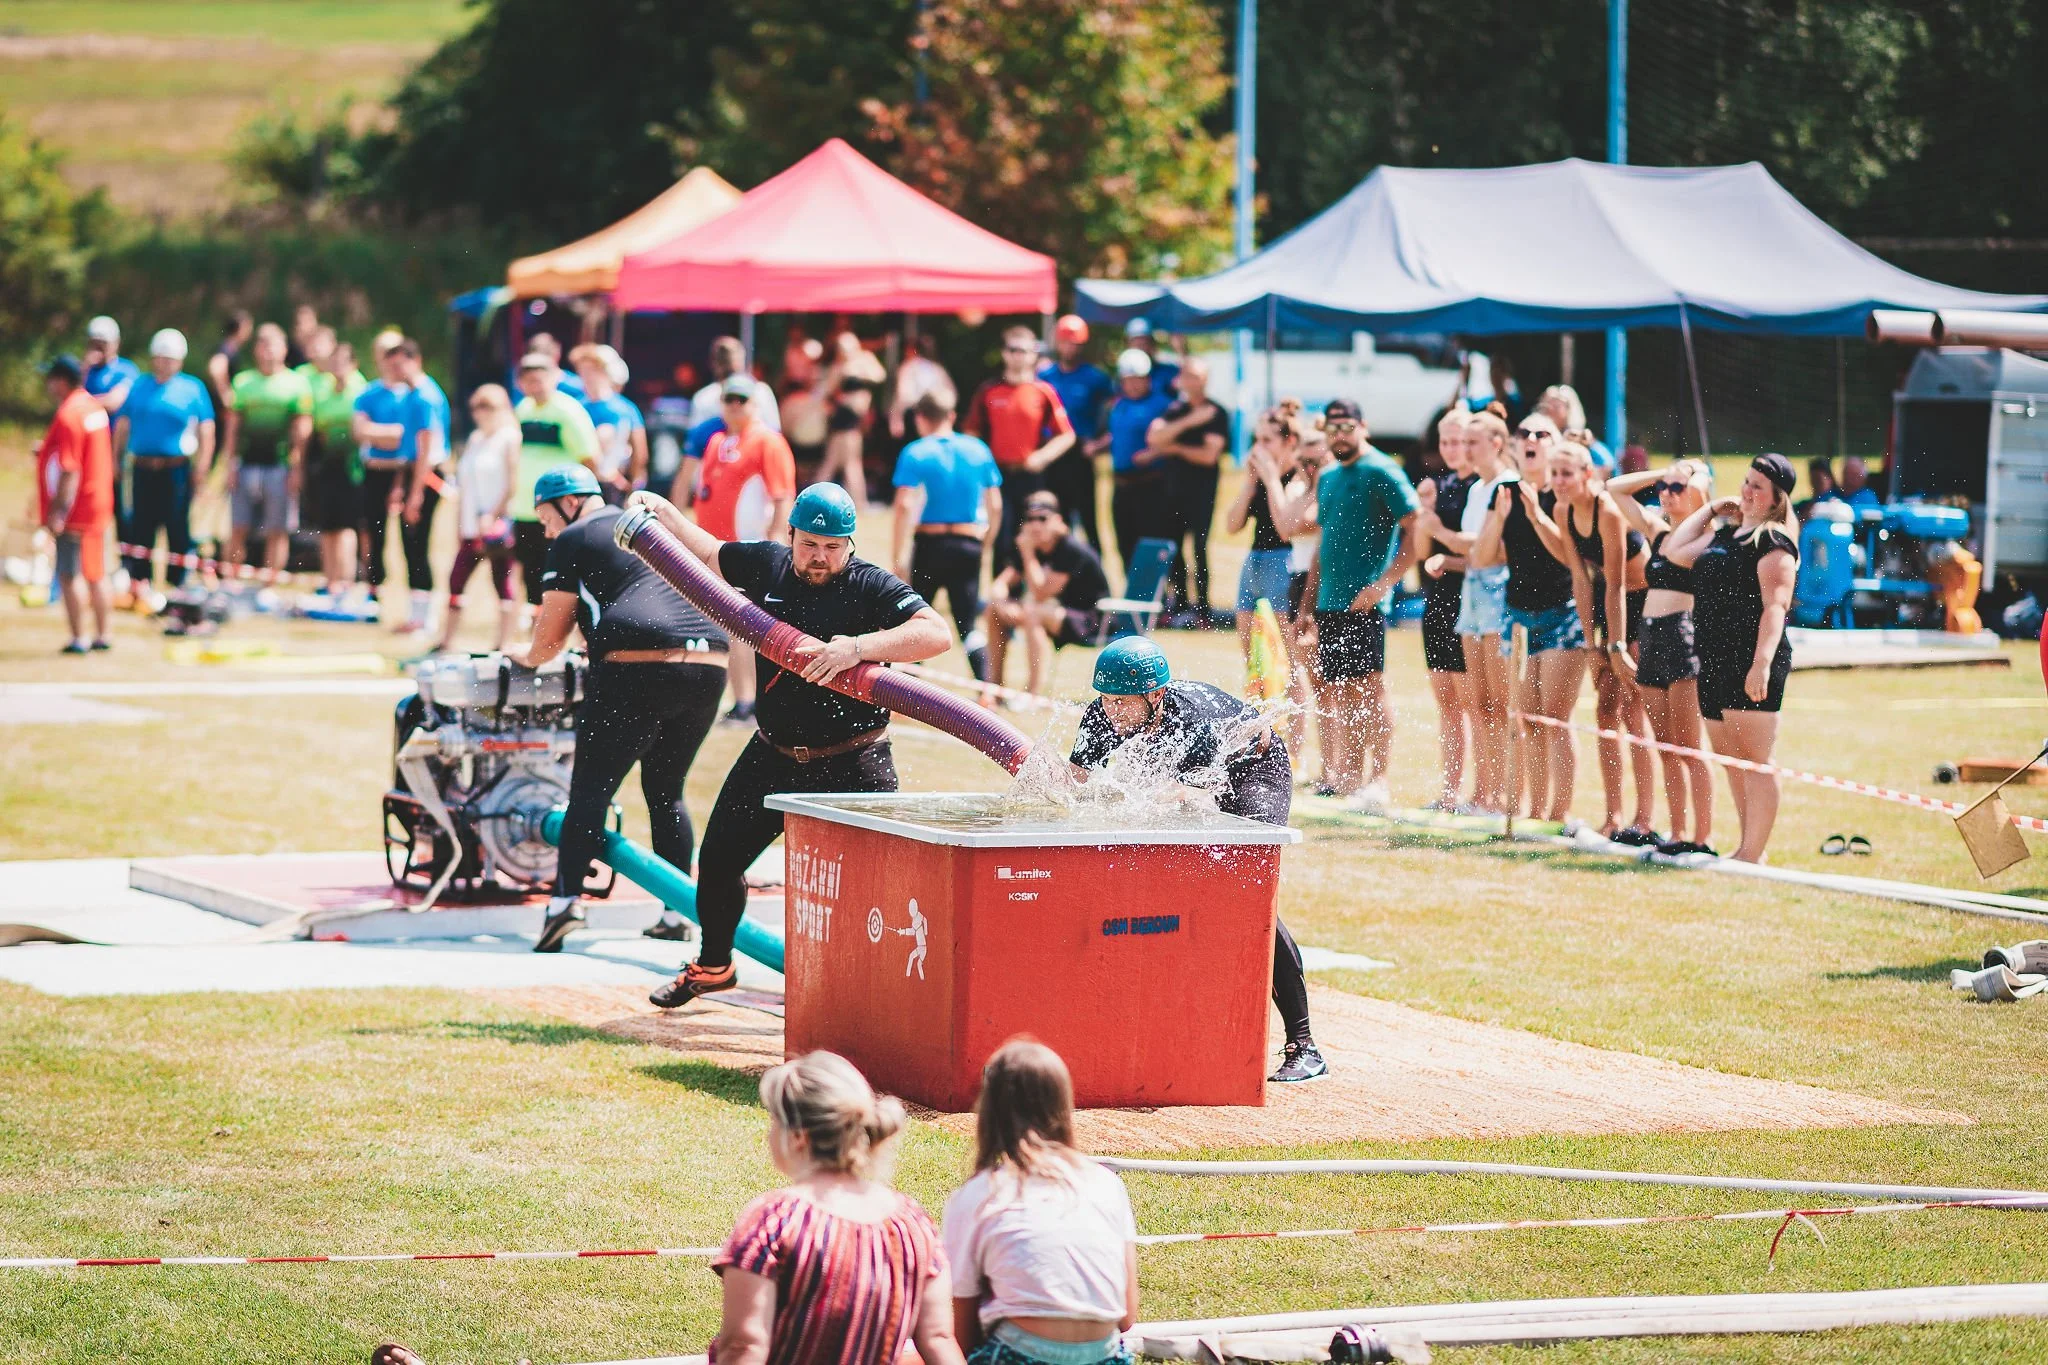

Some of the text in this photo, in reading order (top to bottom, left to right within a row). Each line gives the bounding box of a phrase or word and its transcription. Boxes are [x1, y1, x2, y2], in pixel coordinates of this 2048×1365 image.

[789, 844, 843, 900] POŽÁRNÍ
[997, 866, 1052, 879] Lamitex
[796, 897, 833, 943] SPORT
